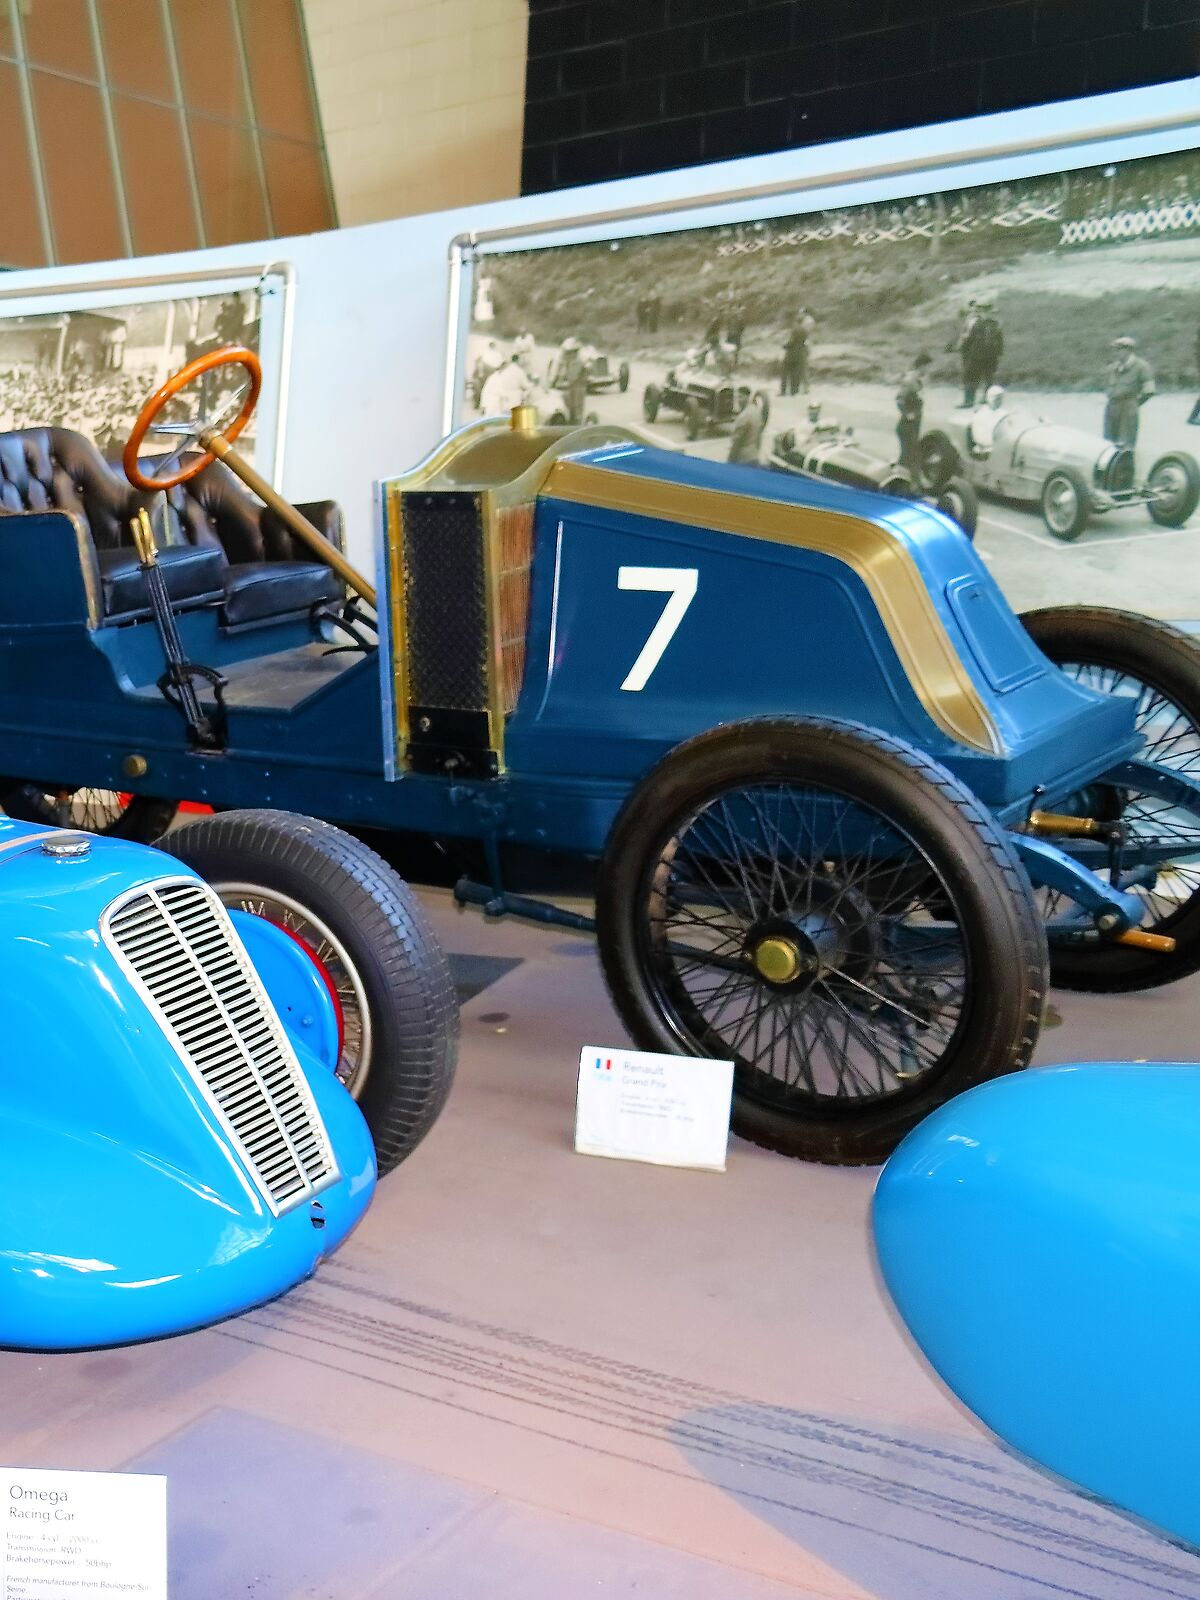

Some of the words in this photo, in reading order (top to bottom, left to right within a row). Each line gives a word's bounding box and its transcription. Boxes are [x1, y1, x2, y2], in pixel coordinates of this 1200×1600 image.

[618, 566, 699, 692] 7
[9, 1485, 68, 1506] Omega
[9, 1506, 50, 1523] Racing
[54, 1509, 75, 1521] Car
